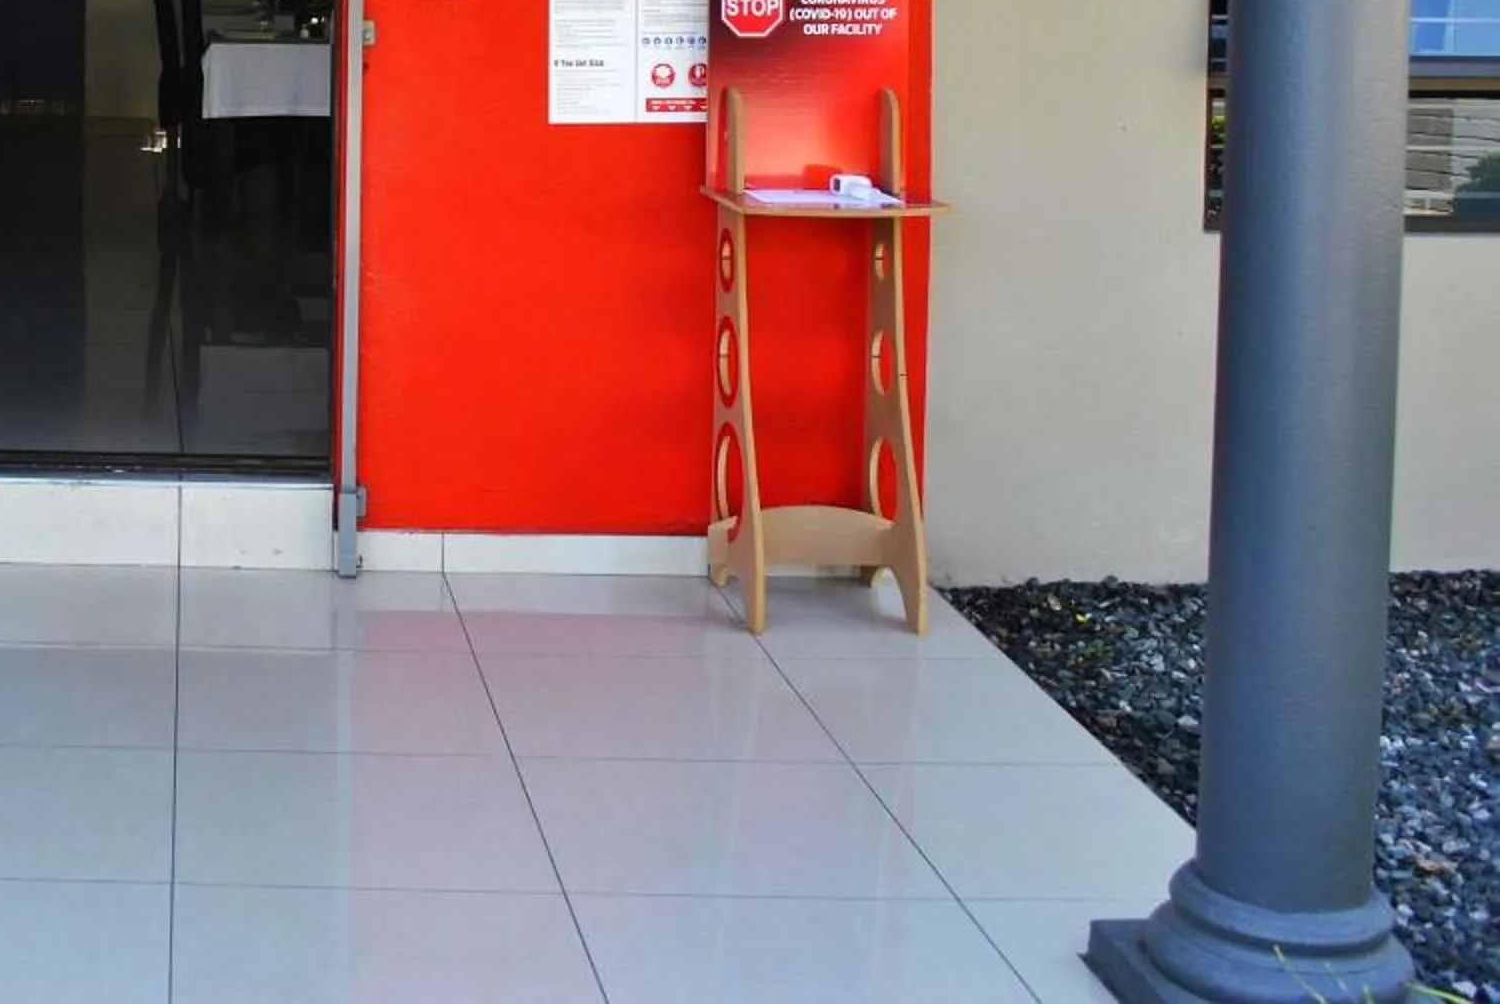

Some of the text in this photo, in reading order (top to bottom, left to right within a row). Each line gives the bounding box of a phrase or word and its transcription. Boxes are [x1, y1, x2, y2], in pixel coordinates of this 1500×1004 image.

[789, 7, 898, 21] (COVID-19) OUT OF
[803, 23, 883, 36] OUR FACILITY
